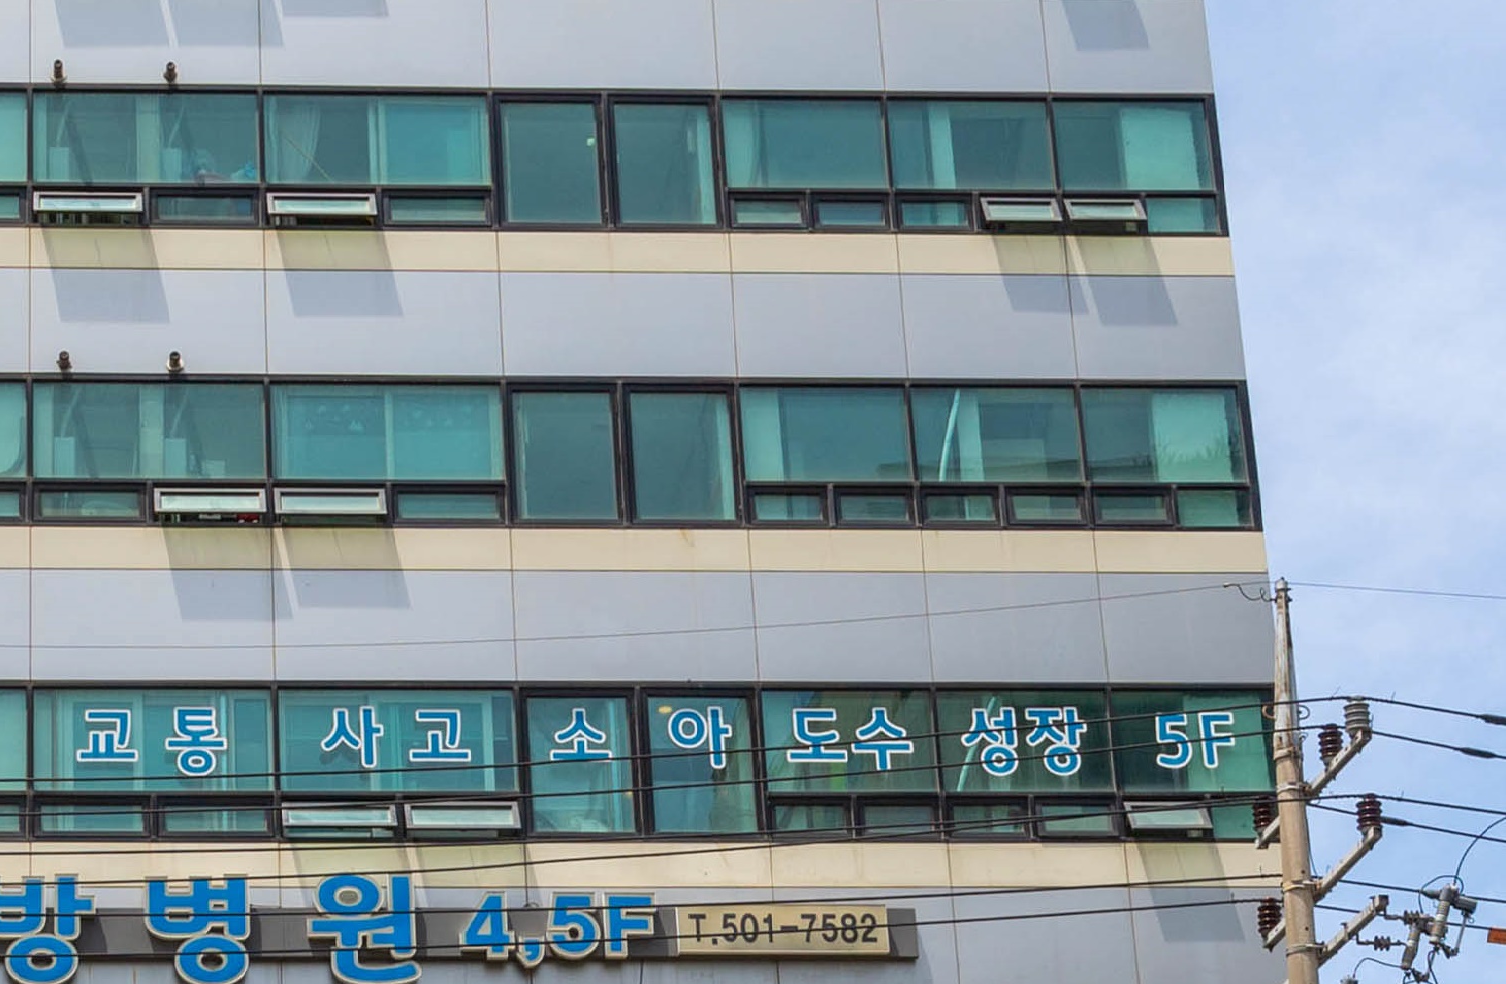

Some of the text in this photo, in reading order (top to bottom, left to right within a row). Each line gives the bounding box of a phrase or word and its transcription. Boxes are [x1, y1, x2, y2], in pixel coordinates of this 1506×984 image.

[77, 706, 227, 777] 교통
[321, 705, 471, 769] 사고
[1155, 710, 1235, 769] 5F
[460, 891, 656, 969] 4,5F
[687, 911, 878, 947] T.501-7582
